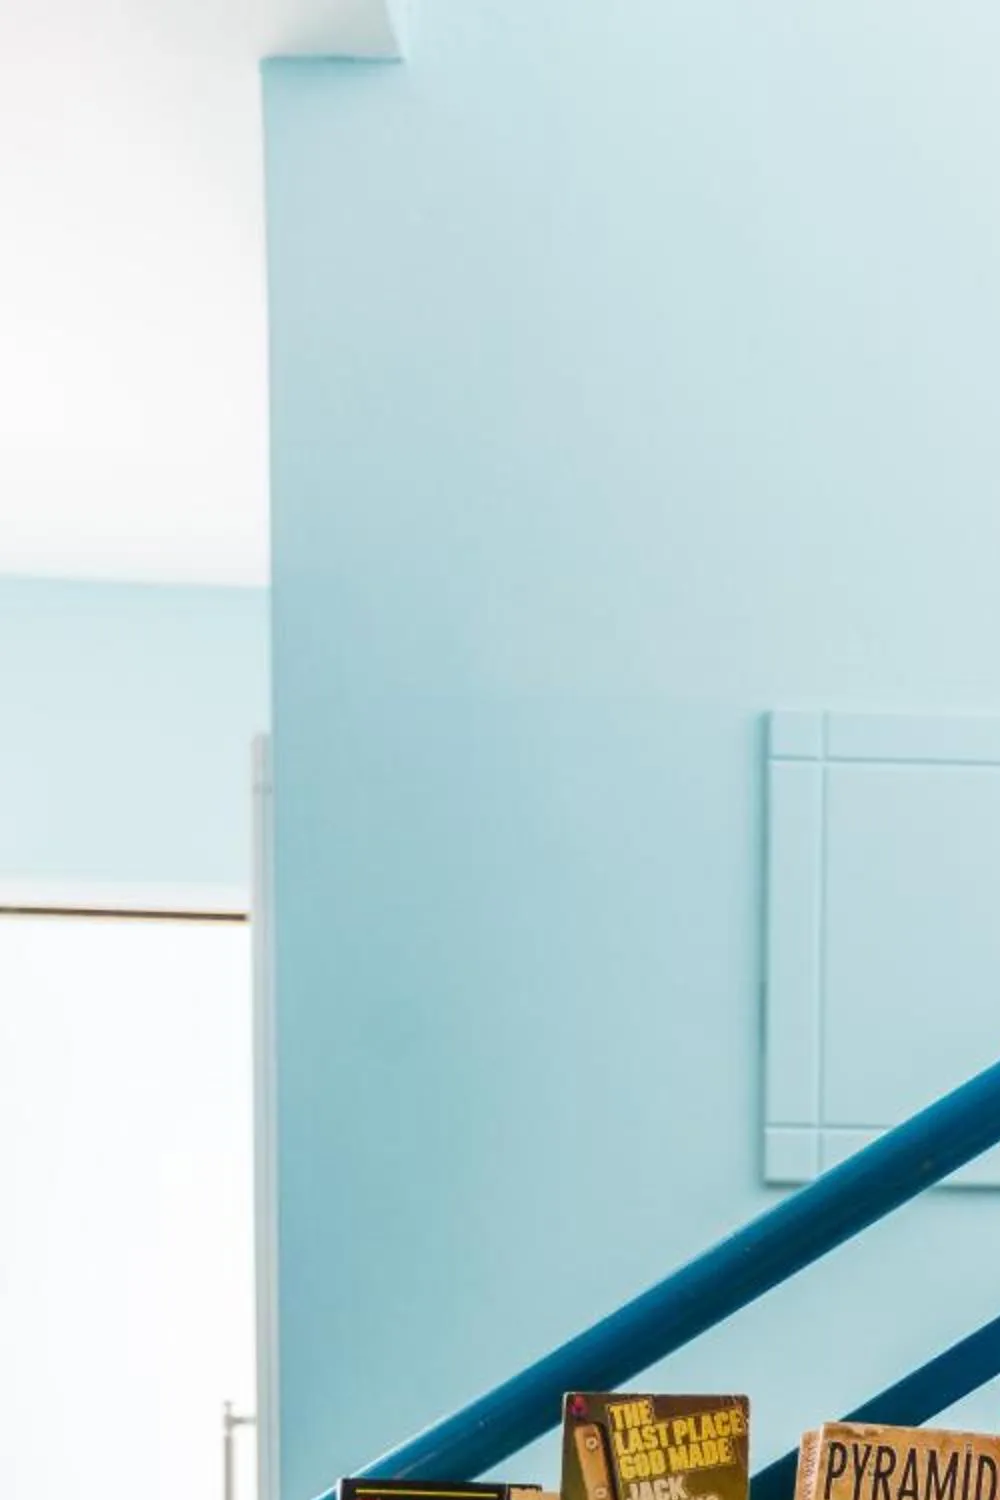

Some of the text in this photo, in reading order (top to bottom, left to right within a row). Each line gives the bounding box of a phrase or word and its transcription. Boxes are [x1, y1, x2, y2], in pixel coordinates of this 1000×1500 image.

[609, 1400, 651, 1430] THE
[613, 1406, 746, 1456] LAST PLACE
[620, 1437, 733, 1480] GOD MADE
